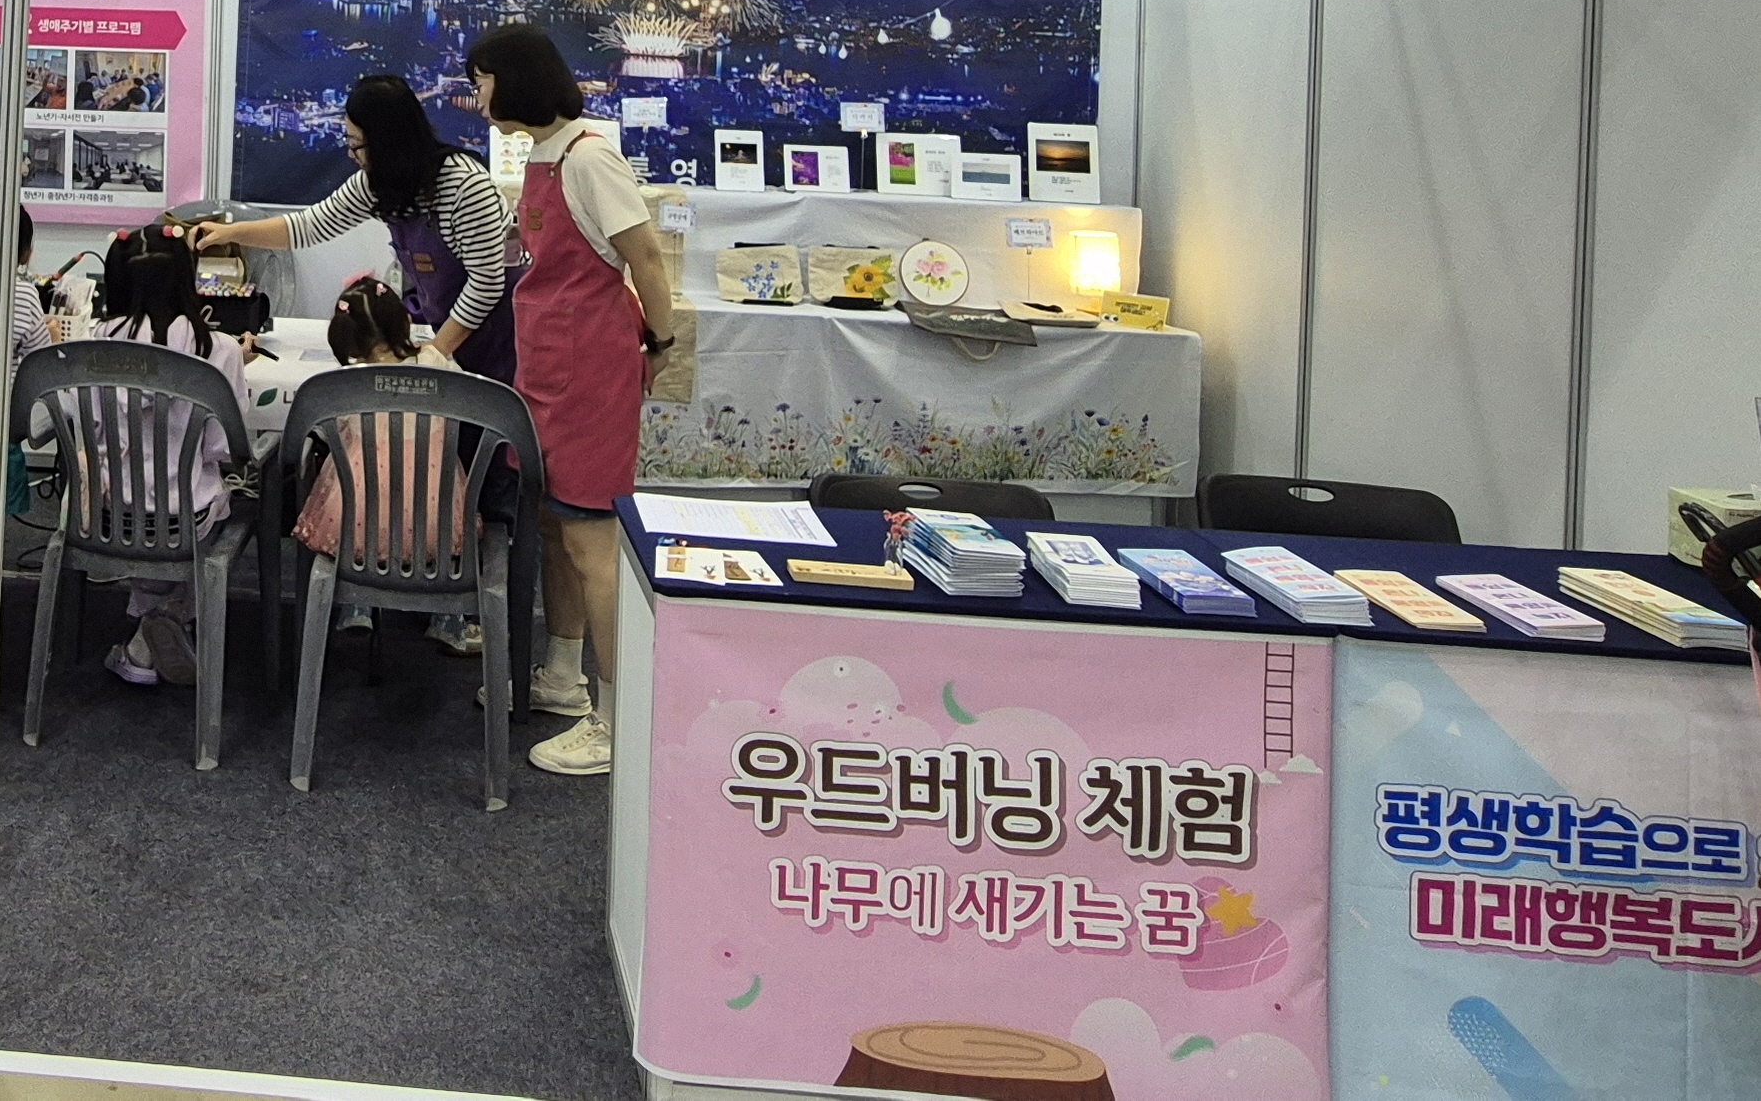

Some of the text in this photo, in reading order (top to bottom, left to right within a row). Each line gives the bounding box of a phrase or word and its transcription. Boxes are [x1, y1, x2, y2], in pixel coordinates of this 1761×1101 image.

[96, 20, 142, 36] 프로그램
[727, 731, 1254, 857] 우드버닝 체험
[1381, 789, 1742, 875] 평생학습으로
[774, 860, 1200, 949] 나무에 새기는 꿈
